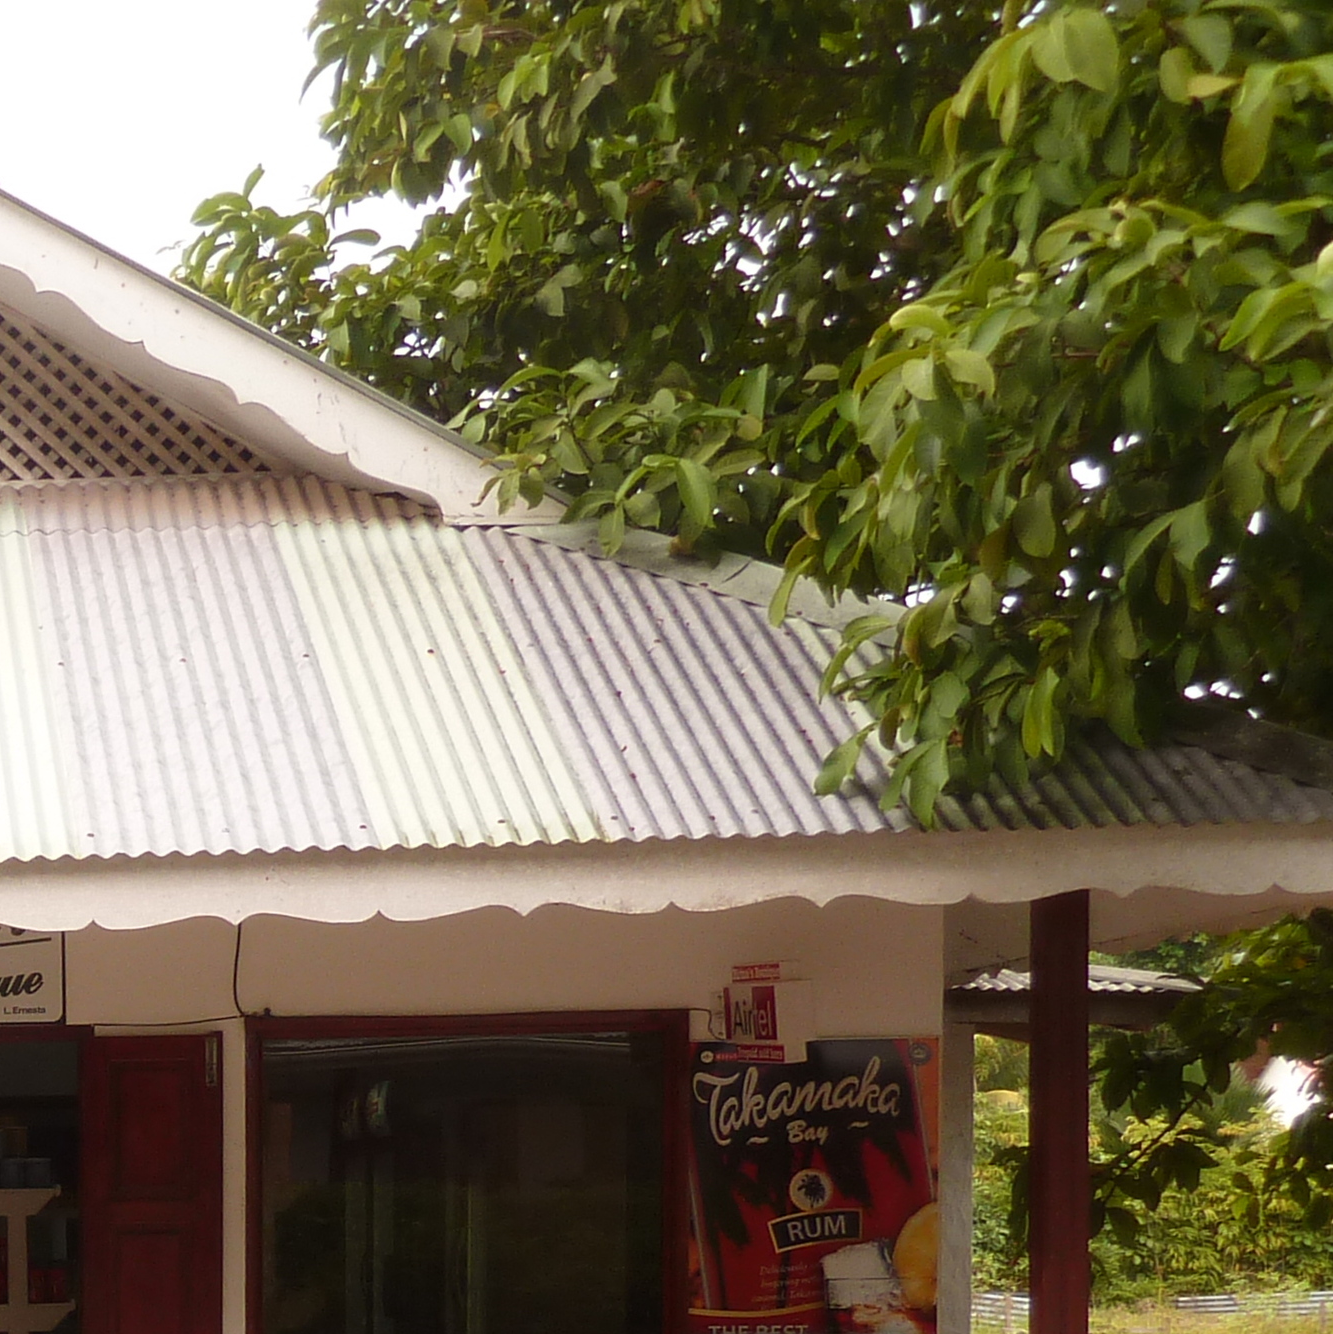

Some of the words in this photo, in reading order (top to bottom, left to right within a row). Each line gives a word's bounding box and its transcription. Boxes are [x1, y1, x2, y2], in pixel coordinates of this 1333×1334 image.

[733, 998, 773, 1036] Airtel
[693, 1055, 900, 1146] Takamaka
[786, 1120, 830, 1145] Bay
[786, 1214, 846, 1242] RUM
